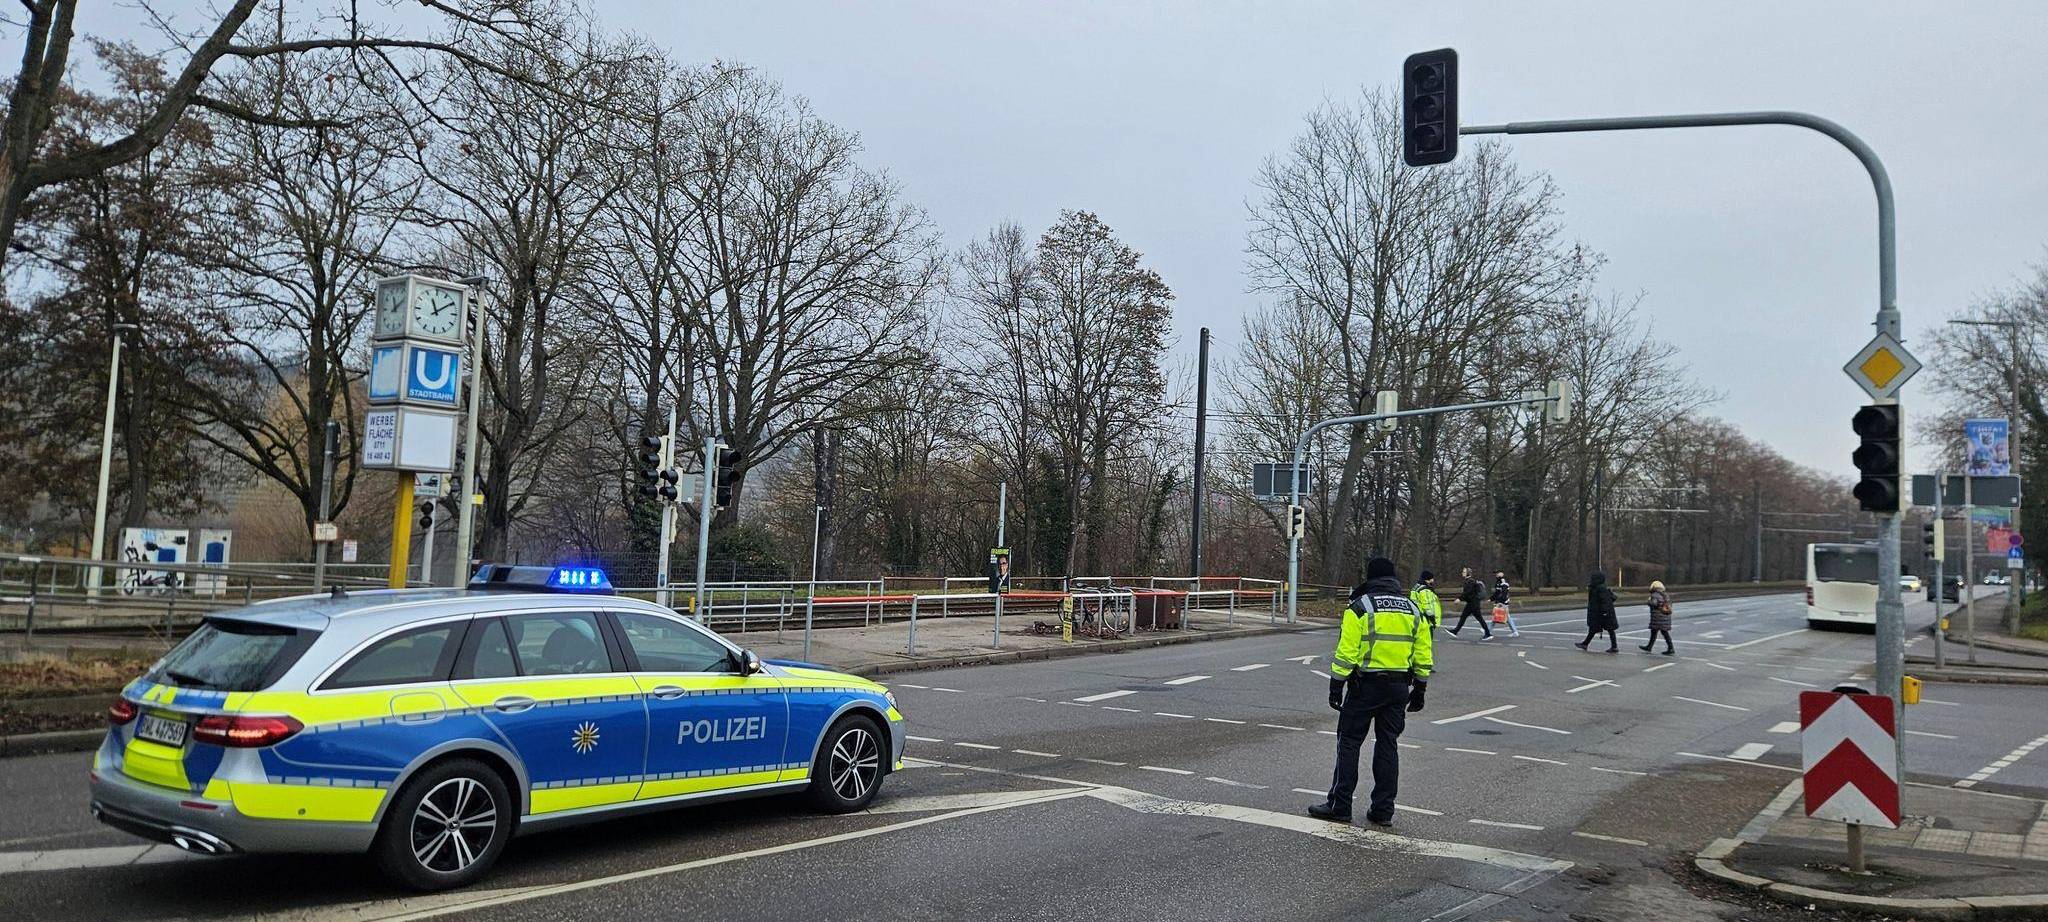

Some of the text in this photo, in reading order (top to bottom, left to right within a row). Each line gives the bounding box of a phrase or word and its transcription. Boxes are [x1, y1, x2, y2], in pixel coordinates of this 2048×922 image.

[417, 351, 451, 390] U
[410, 389, 454, 401] STADTBAHN
[370, 415, 394, 426] WERBE
[1376, 599, 1409, 609] POLIZEI
[678, 716, 767, 745] POLIZEI
